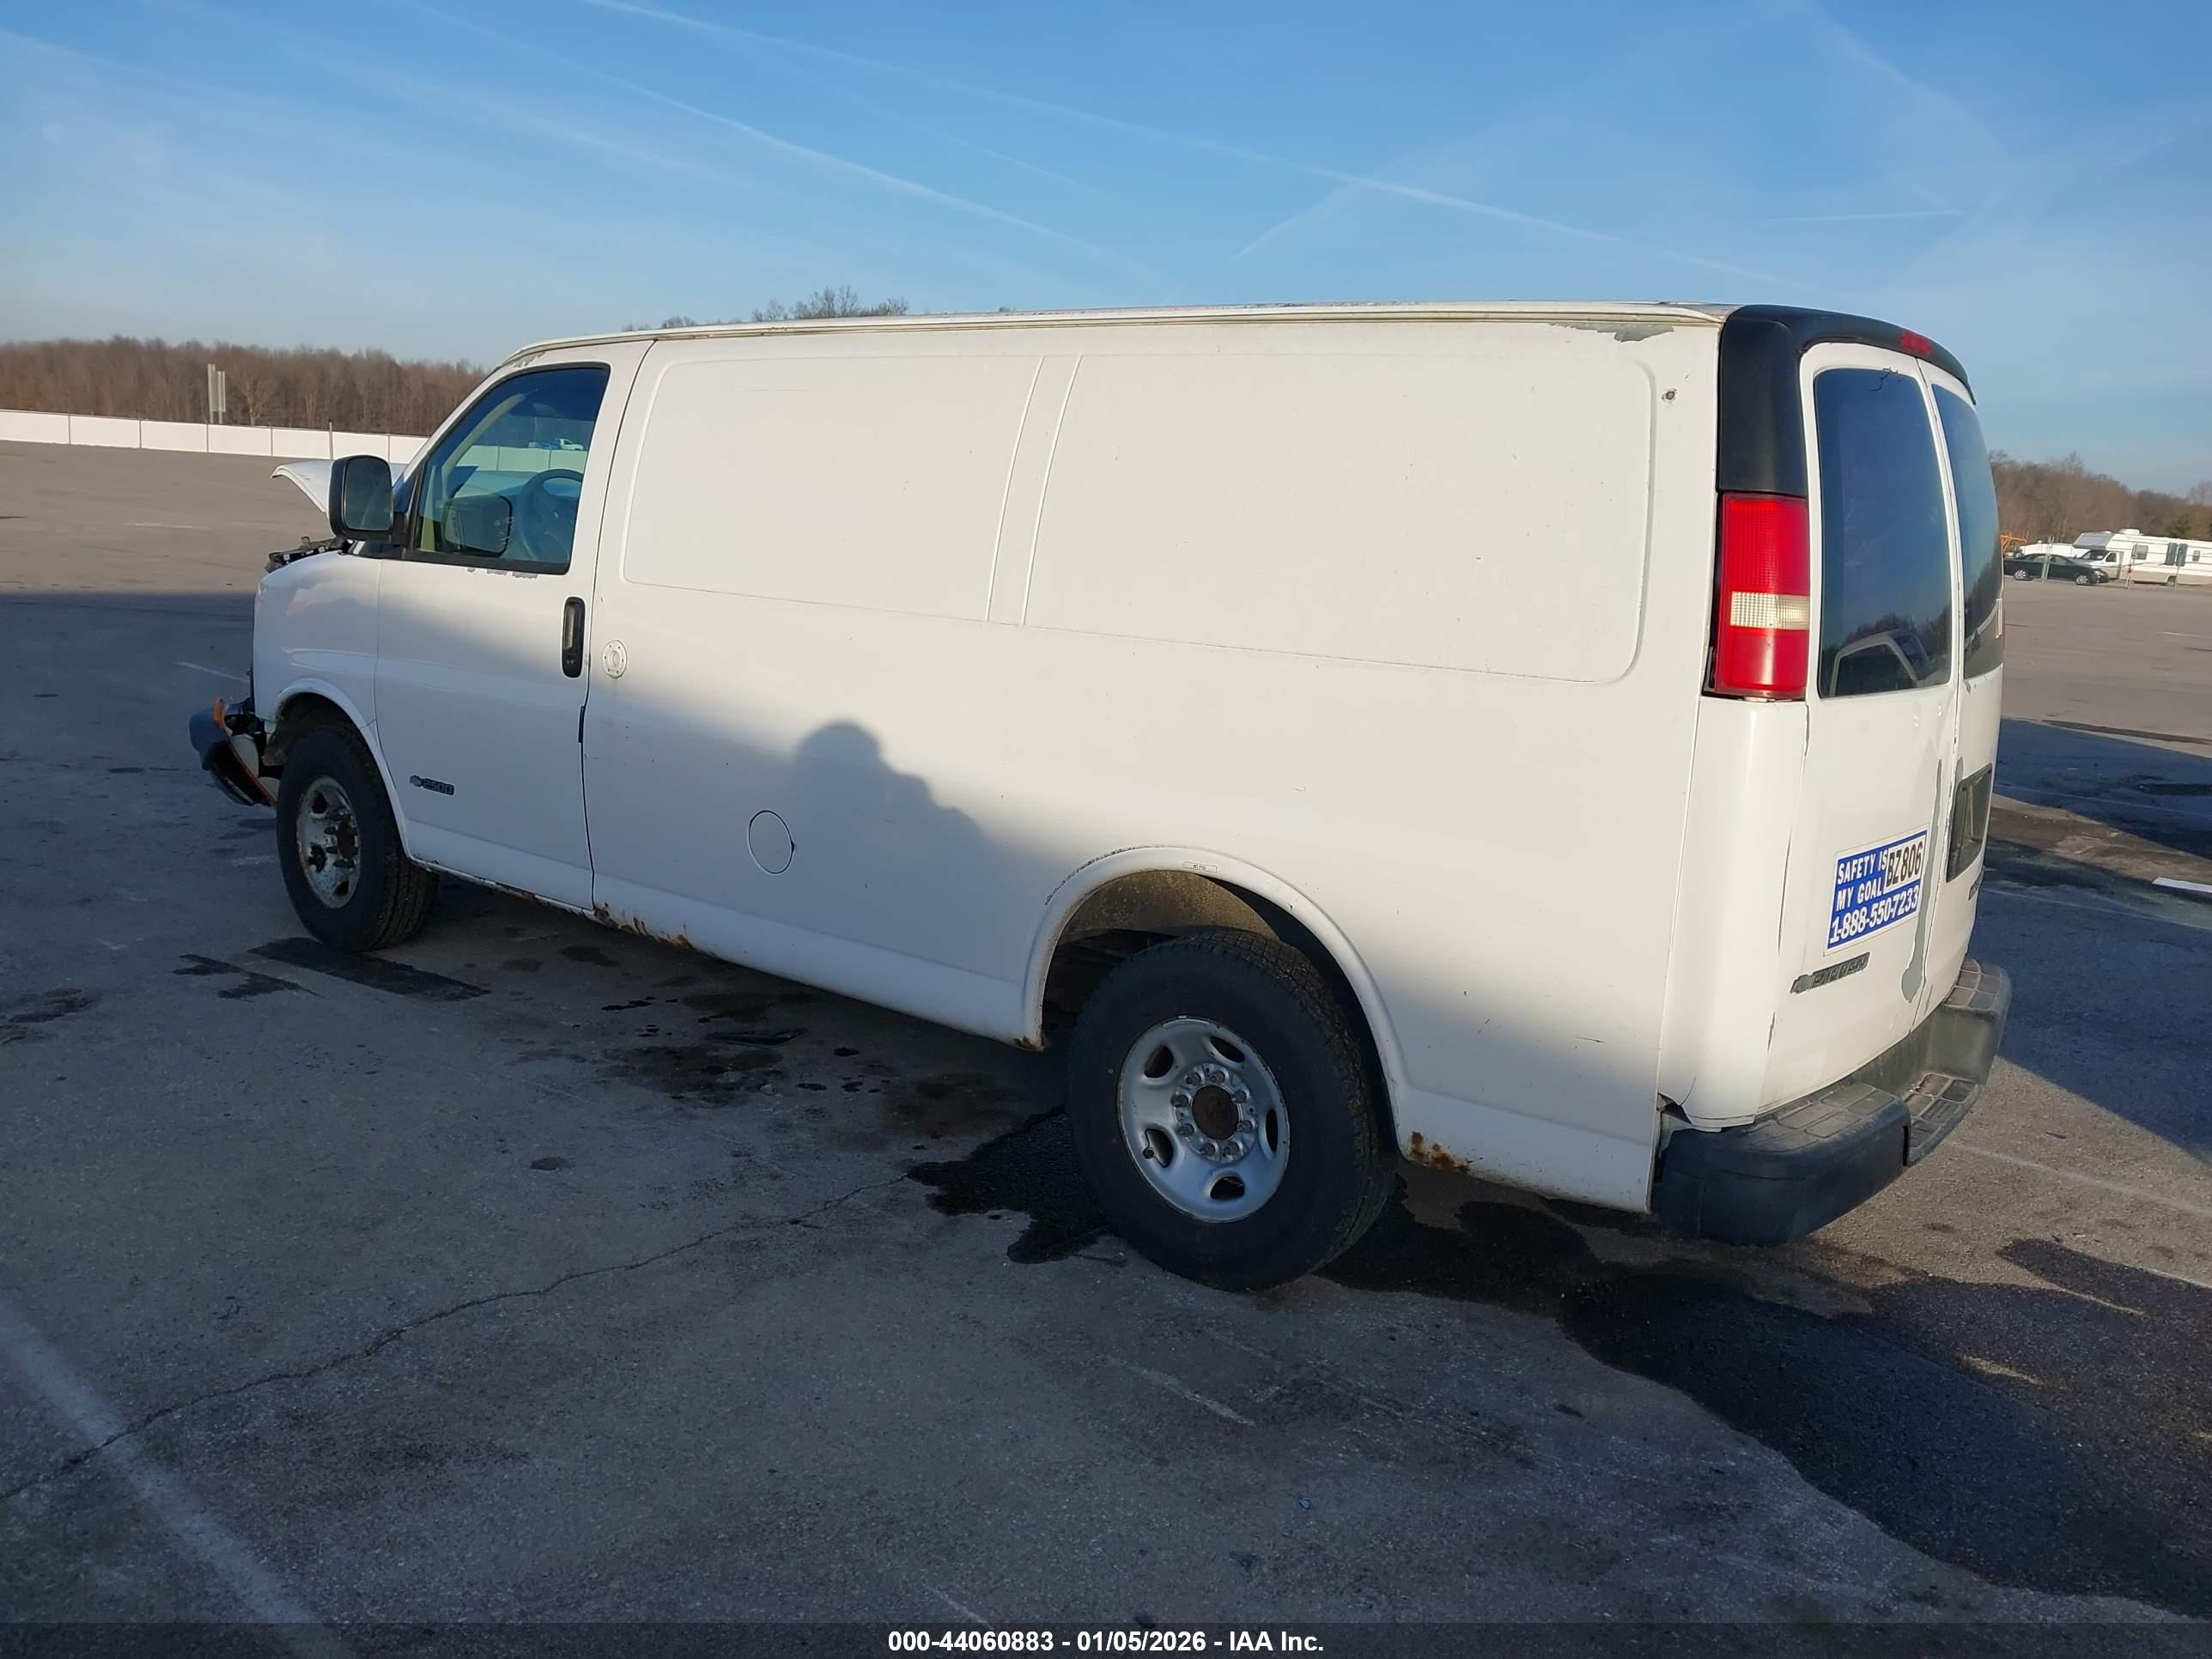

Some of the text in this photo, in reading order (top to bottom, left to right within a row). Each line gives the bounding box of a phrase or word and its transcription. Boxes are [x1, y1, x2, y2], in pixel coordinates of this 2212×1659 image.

[1838, 849, 1888, 884] SAFETY IS
[1836, 877, 1882, 912] MY GOAL
[1830, 884, 1919, 944] 1-888-550-7233
